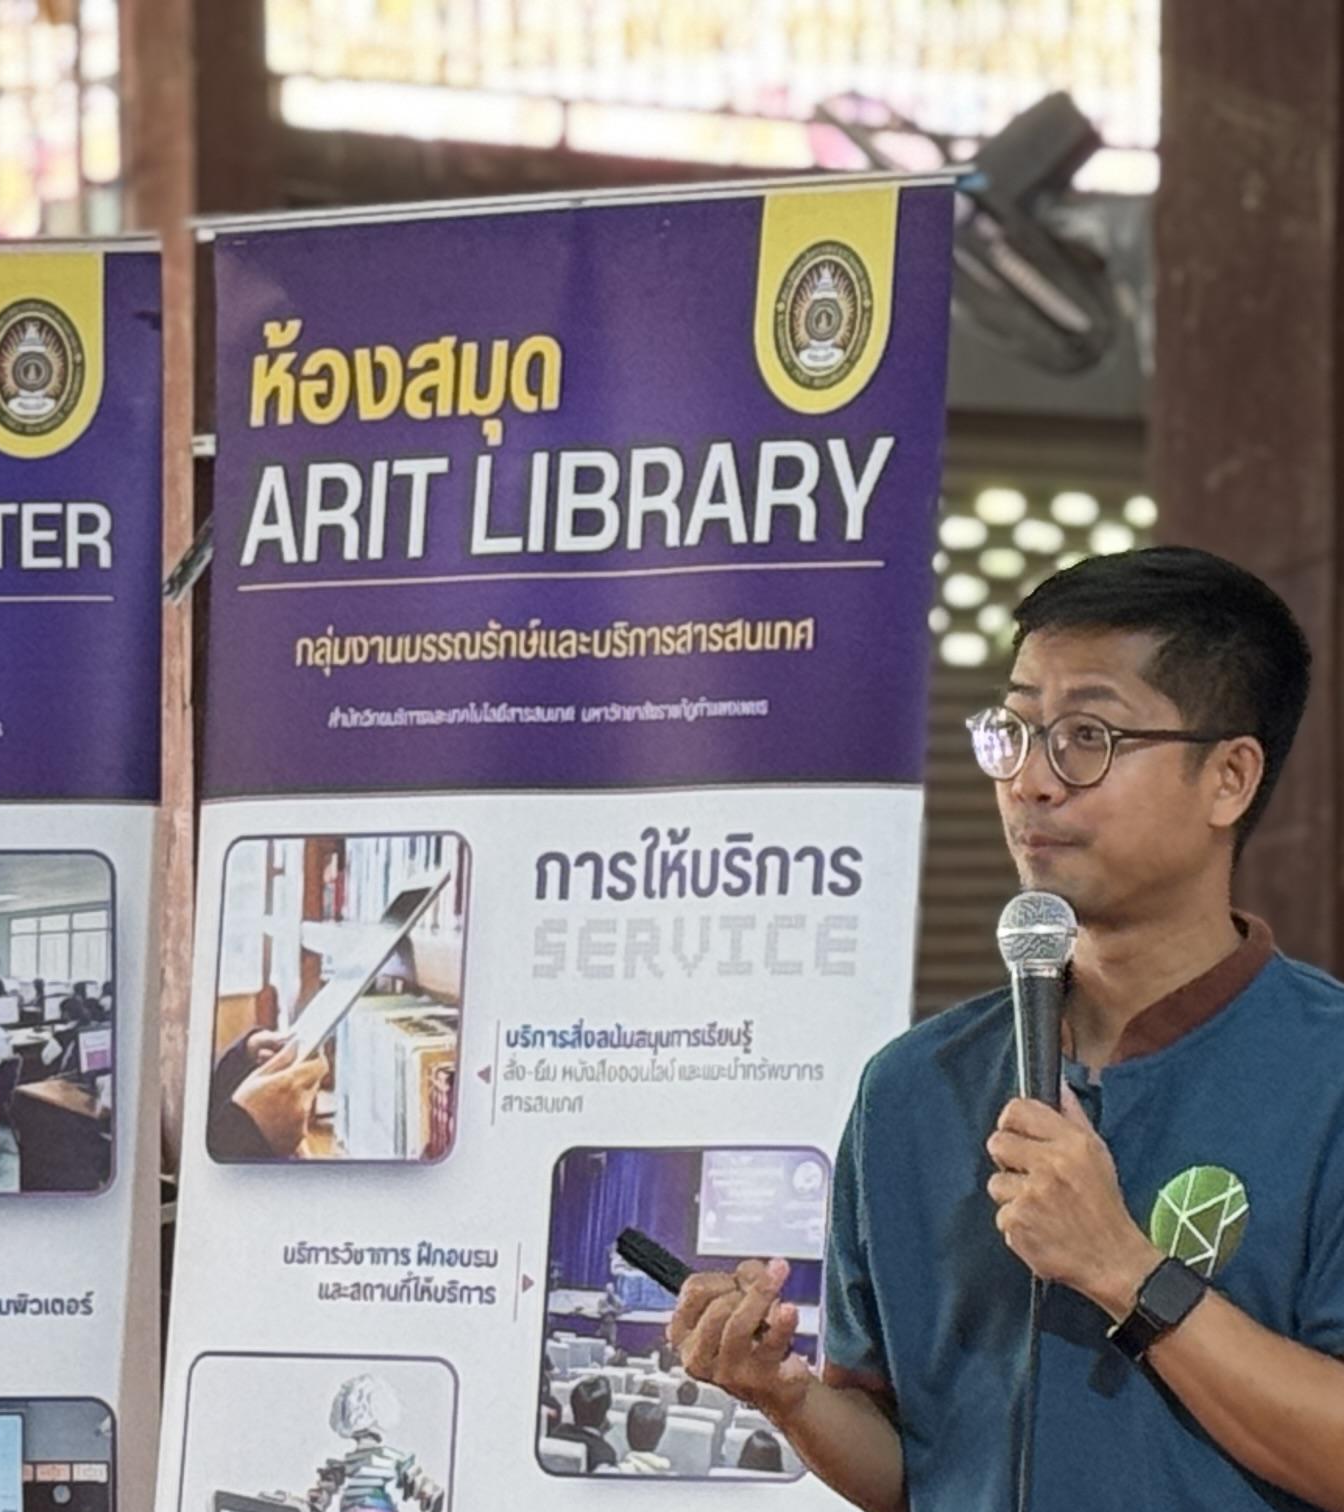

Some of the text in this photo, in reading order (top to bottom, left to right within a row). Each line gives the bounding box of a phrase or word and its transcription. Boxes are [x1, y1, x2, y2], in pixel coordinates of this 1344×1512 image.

[249, 317, 563, 445] ห้องสมุด
[240, 435, 896, 567] ARIT LIBRARY
[295, 617, 815, 677] กลุ่มงานบรรณรักษ์และบริการสารสนเทศ
[534, 827, 863, 901] การให้บริการ
[532, 914, 859, 980] SERVICE
